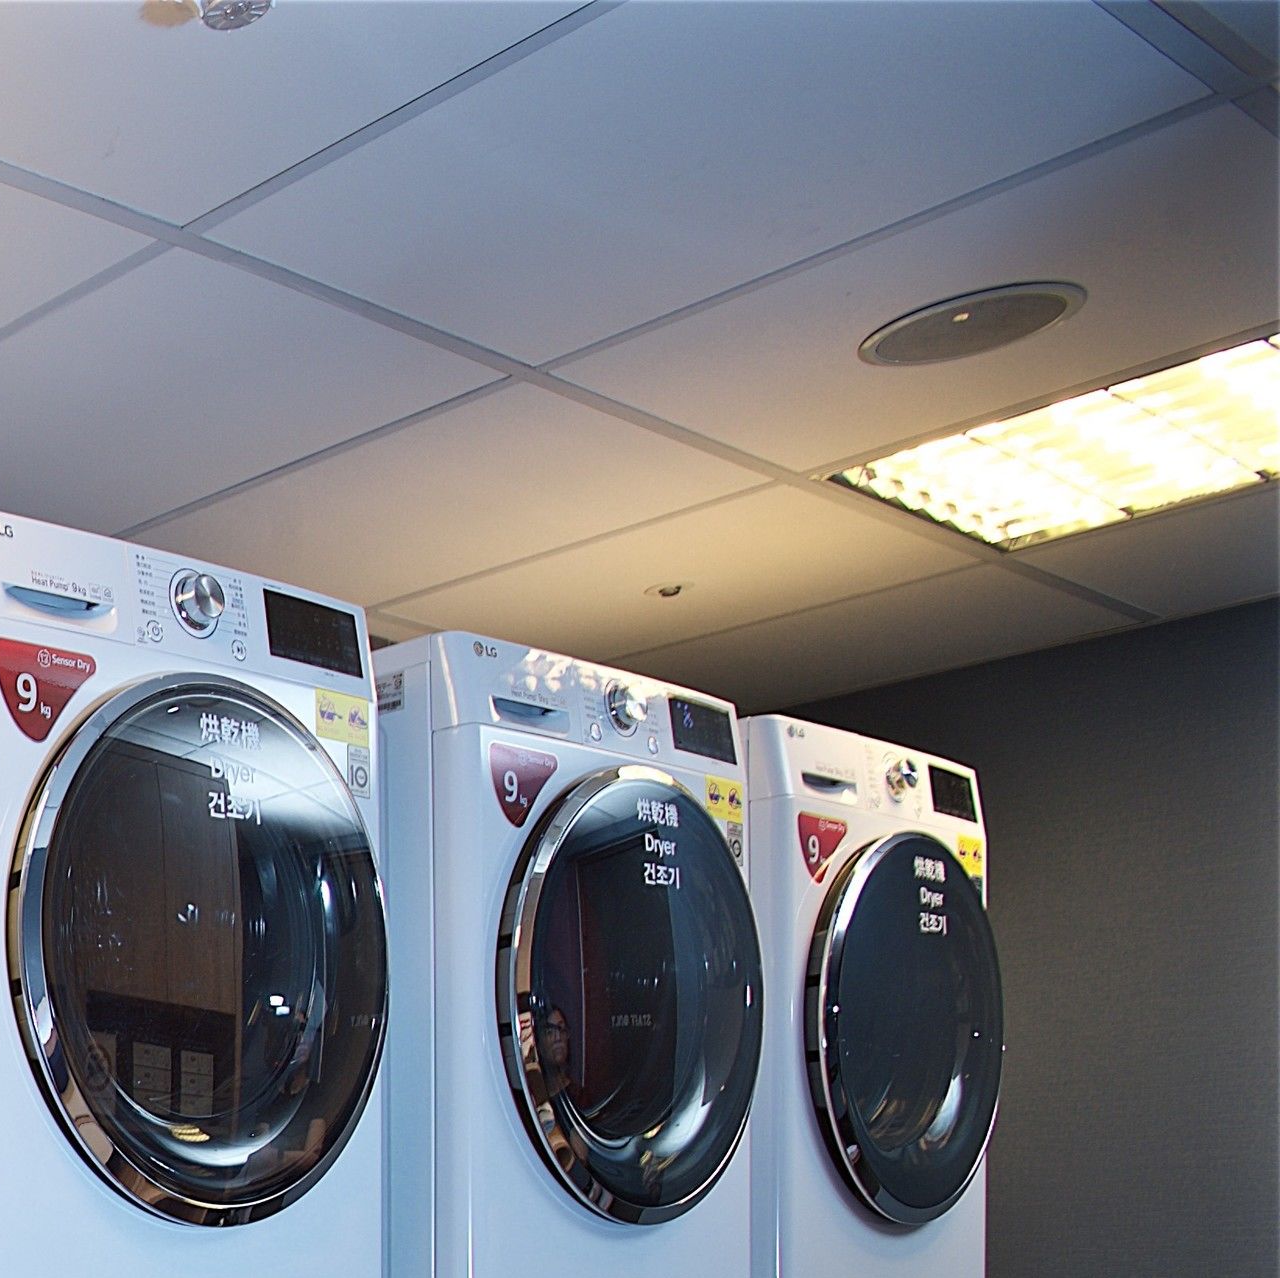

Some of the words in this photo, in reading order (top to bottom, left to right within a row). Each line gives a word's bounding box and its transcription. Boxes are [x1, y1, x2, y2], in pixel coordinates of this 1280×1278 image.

[51, 653, 76, 668] Sensor
[77, 657, 91, 673] Dry
[485, 646, 497, 658] LG
[16, 672, 38, 712] 9
[40, 702, 52, 719] kg
[199, 712, 261, 745] 烘乾機
[210, 756, 256, 786] Dryer
[503, 771, 519, 802] 9
[209, 791, 261, 825] 건조기
[637, 798, 679, 828] 烘乾機
[644, 833, 676, 857] Dryer
[808, 834, 820, 864] 9
[644, 863, 680, 889] 건조기
[920, 887, 944, 907] Dryer
